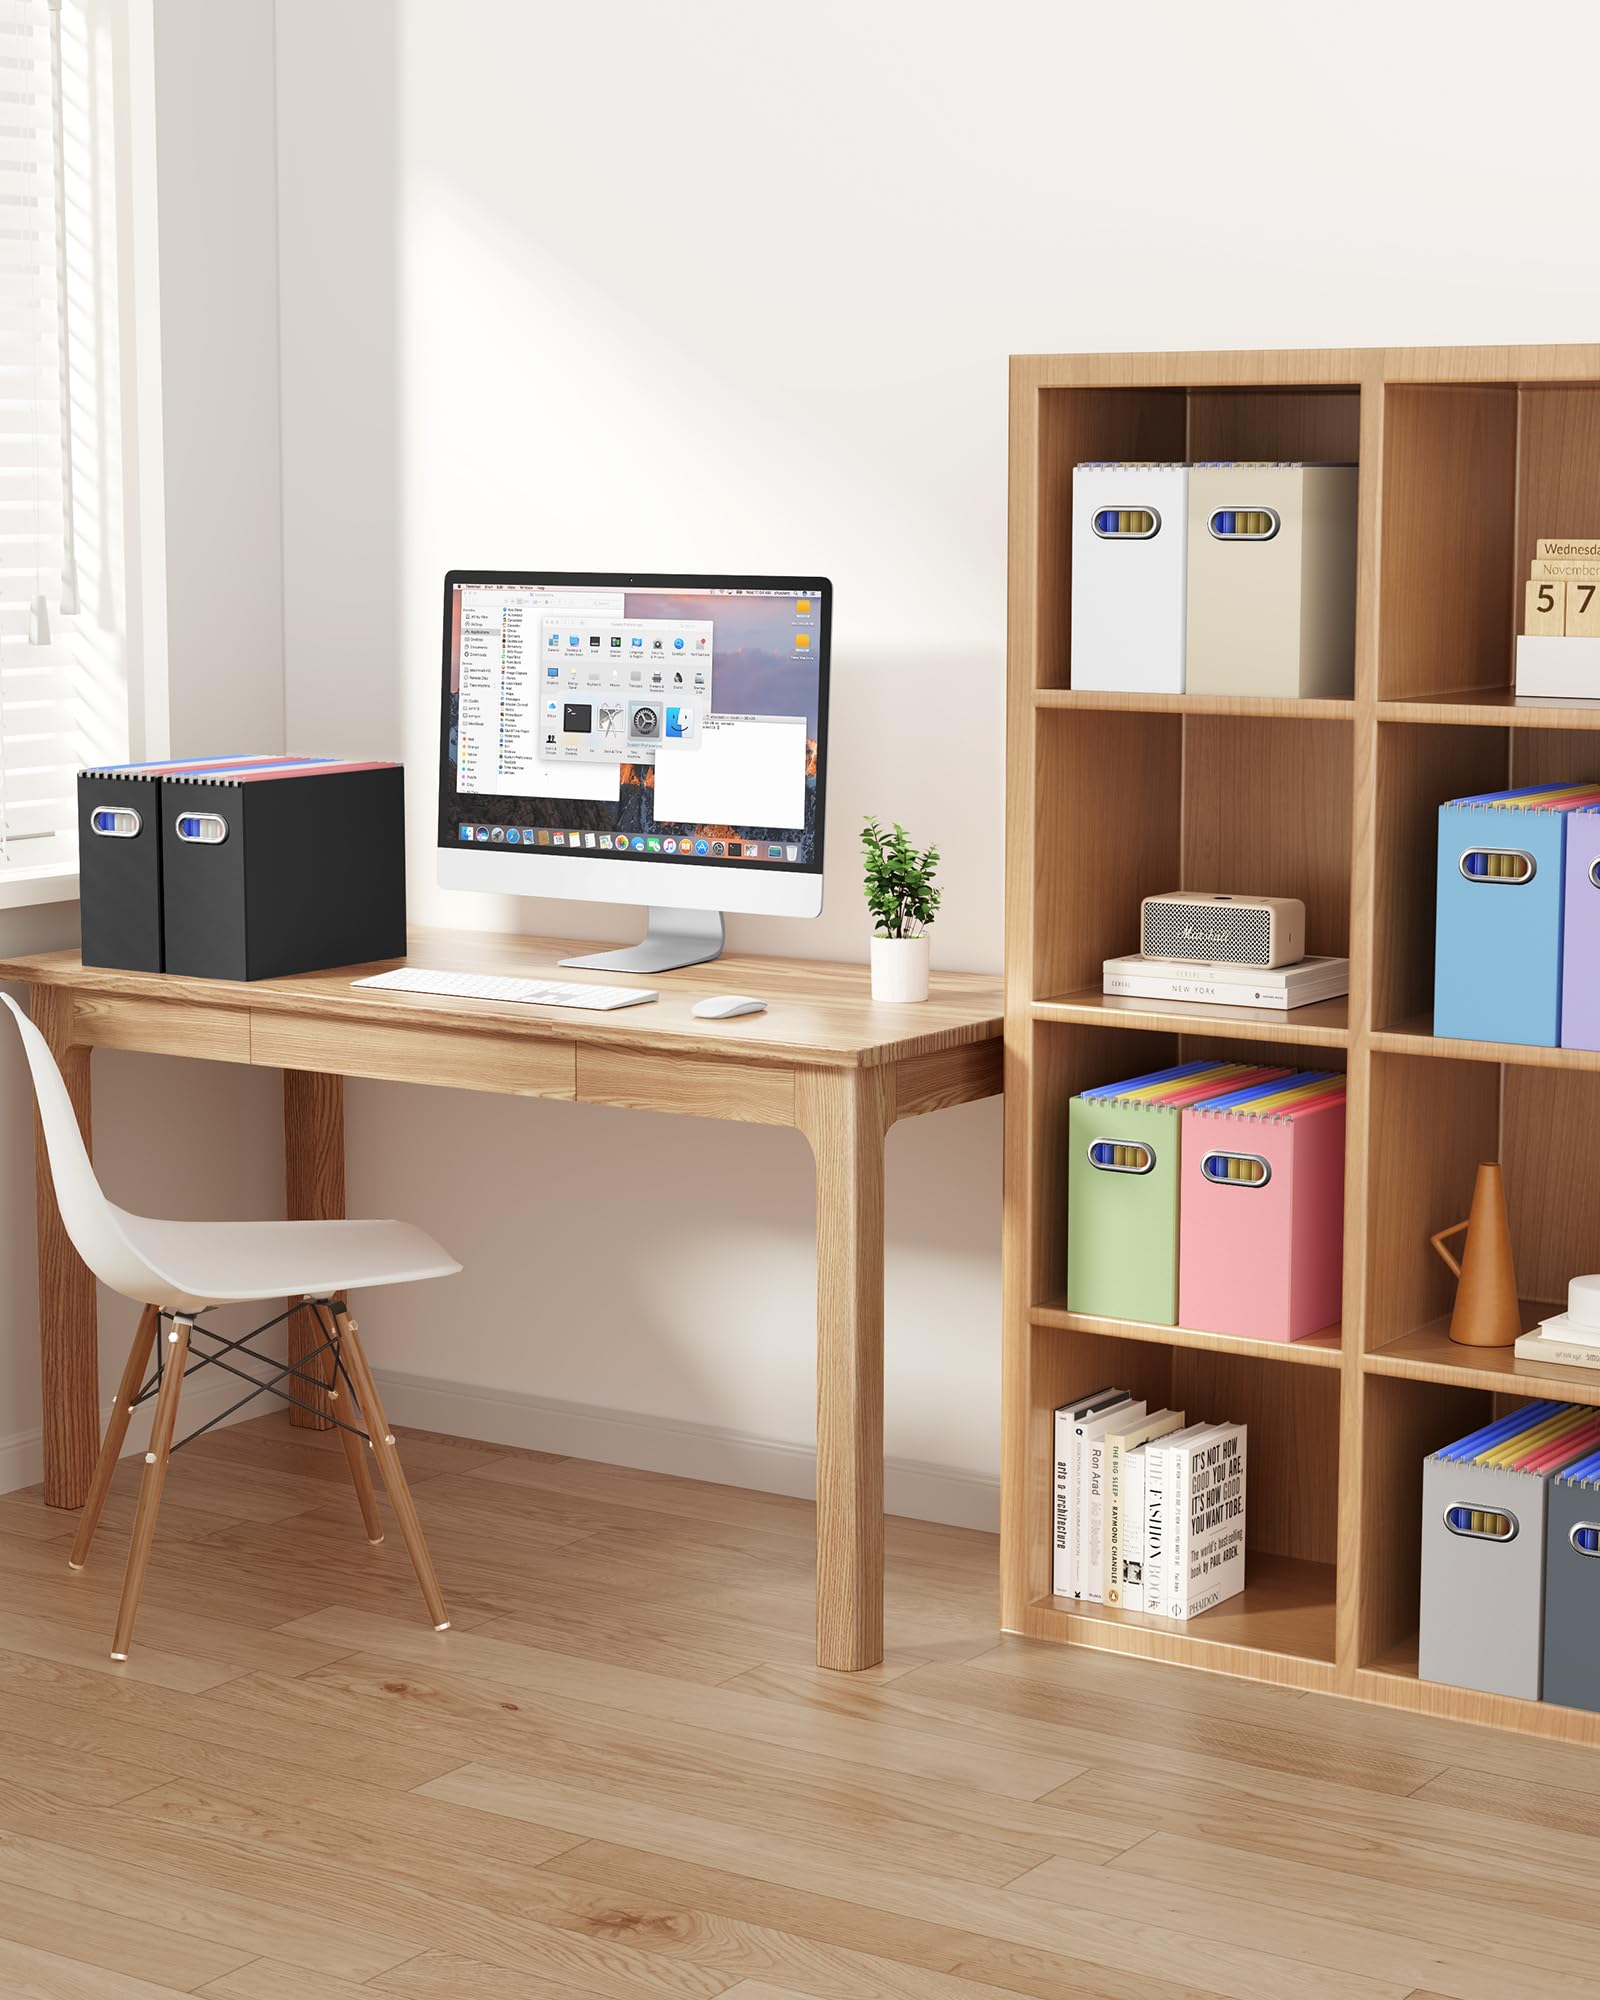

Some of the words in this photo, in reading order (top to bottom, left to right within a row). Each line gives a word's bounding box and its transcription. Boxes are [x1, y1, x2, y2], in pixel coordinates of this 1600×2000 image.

[1537, 584, 1554, 613] 5
[1577, 585, 1596, 613] 7
[1057, 1462, 1067, 1480] arts
[1092, 1449, 1102, 1469] Ron
[1192, 1451, 1206, 1474] IT'S
[1207, 1444, 1220, 1468] NOT
[1222, 1436, 1238, 1460] HOW
[1092, 1471, 1102, 1496] Arad
[1192, 1470, 1210, 1495] GOOD
[1212, 1462, 1226, 1484] YOU
[1192, 1493, 1205, 1516] IT'S
[1206, 1485, 1222, 1509] HOW
[1222, 1476, 1240, 1502] GOOD
[1056, 1494, 1068, 1549] architecture
[1149, 1489, 1162, 1558] FASHION
[1192, 1513, 1205, 1536] YOU
[1206, 1504, 1224, 1530] WANT
[1191, 1550, 1200, 1562] The
[1200, 1539, 1217, 1558] world's
[1218, 1528, 1243, 1551] best-selling
[1190, 1563, 1202, 1580] book
[1202, 1560, 1209, 1575] by
[1210, 1552, 1222, 1570] PAUL
[1189, 1592, 1219, 1616] PHAIDON
